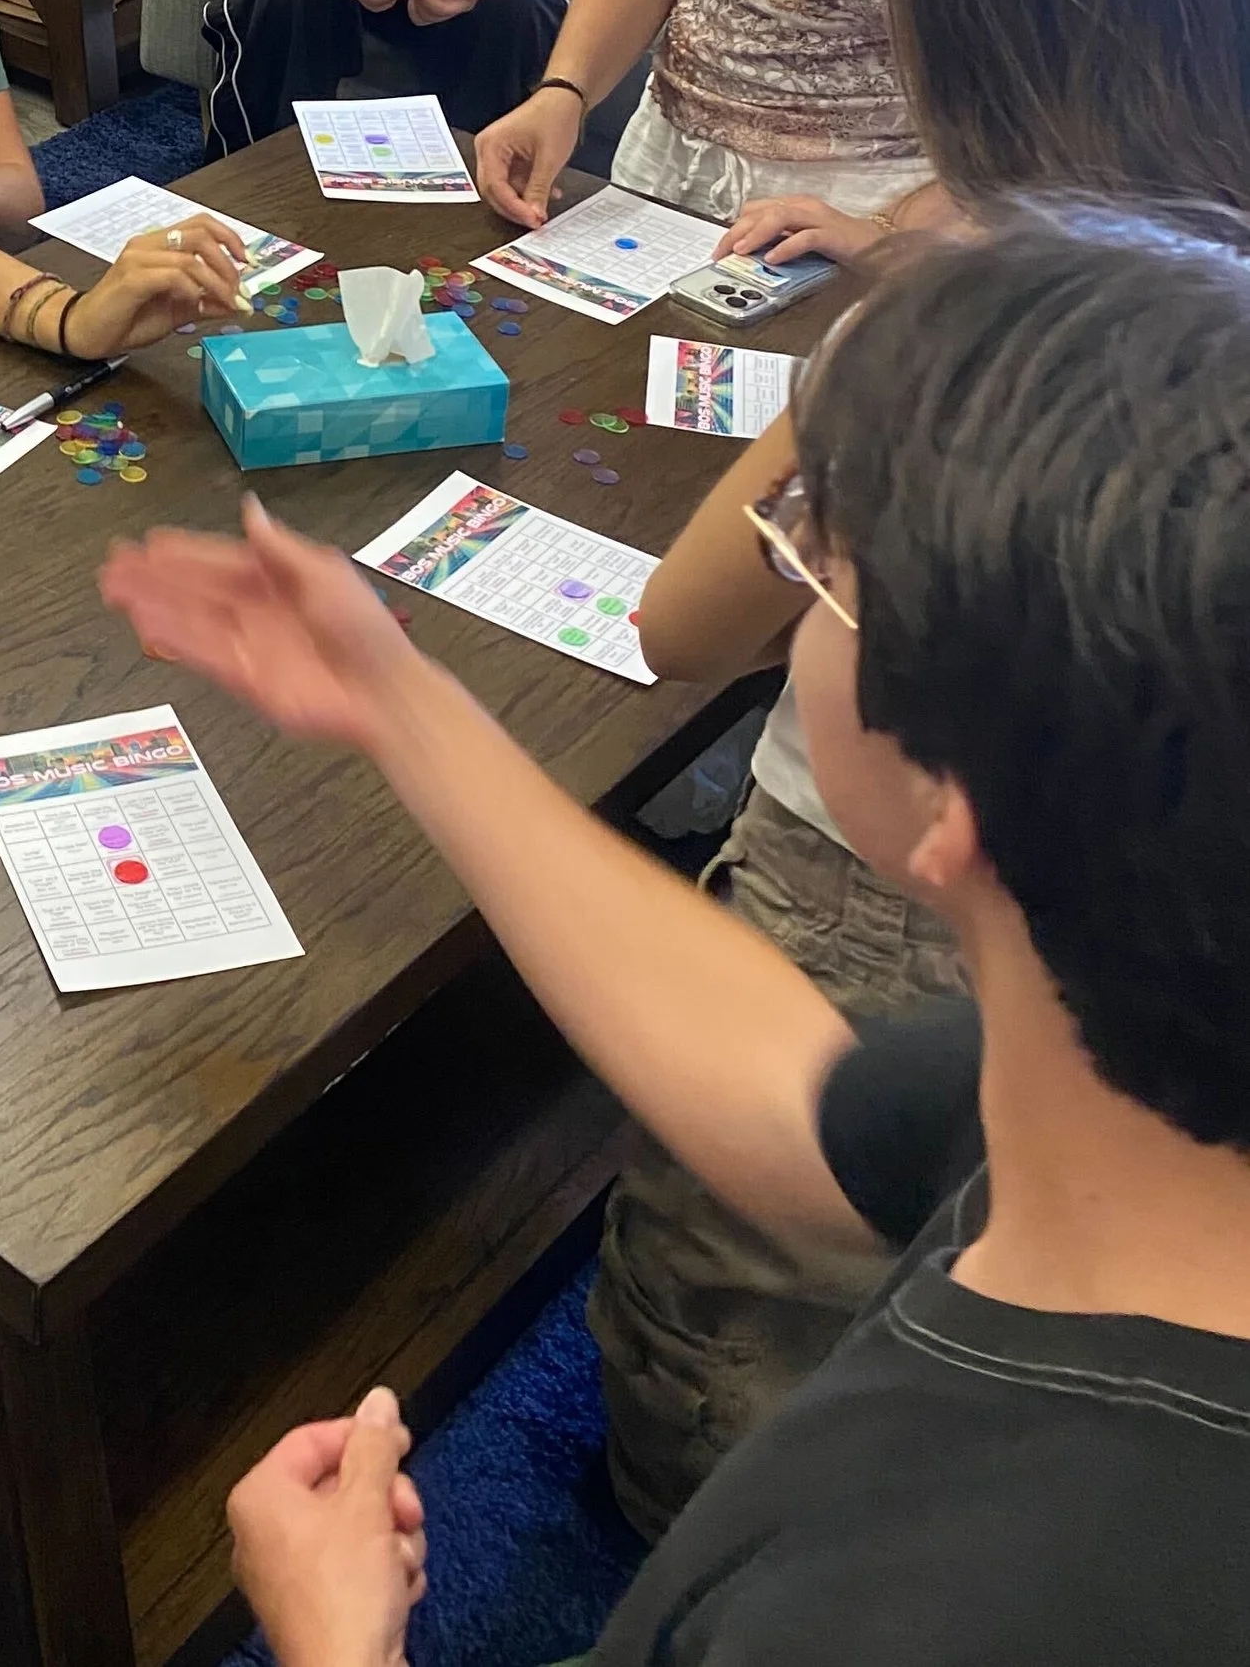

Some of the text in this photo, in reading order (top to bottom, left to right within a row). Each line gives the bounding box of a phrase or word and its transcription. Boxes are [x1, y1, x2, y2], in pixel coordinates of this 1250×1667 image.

[698, 345, 713, 430] BOS MUSIC BINGO
[401, 498, 507, 581] BOS MUSIC BINGO
[32, 759, 110, 785] MUSIC
[112, 744, 185, 769] BINGO
